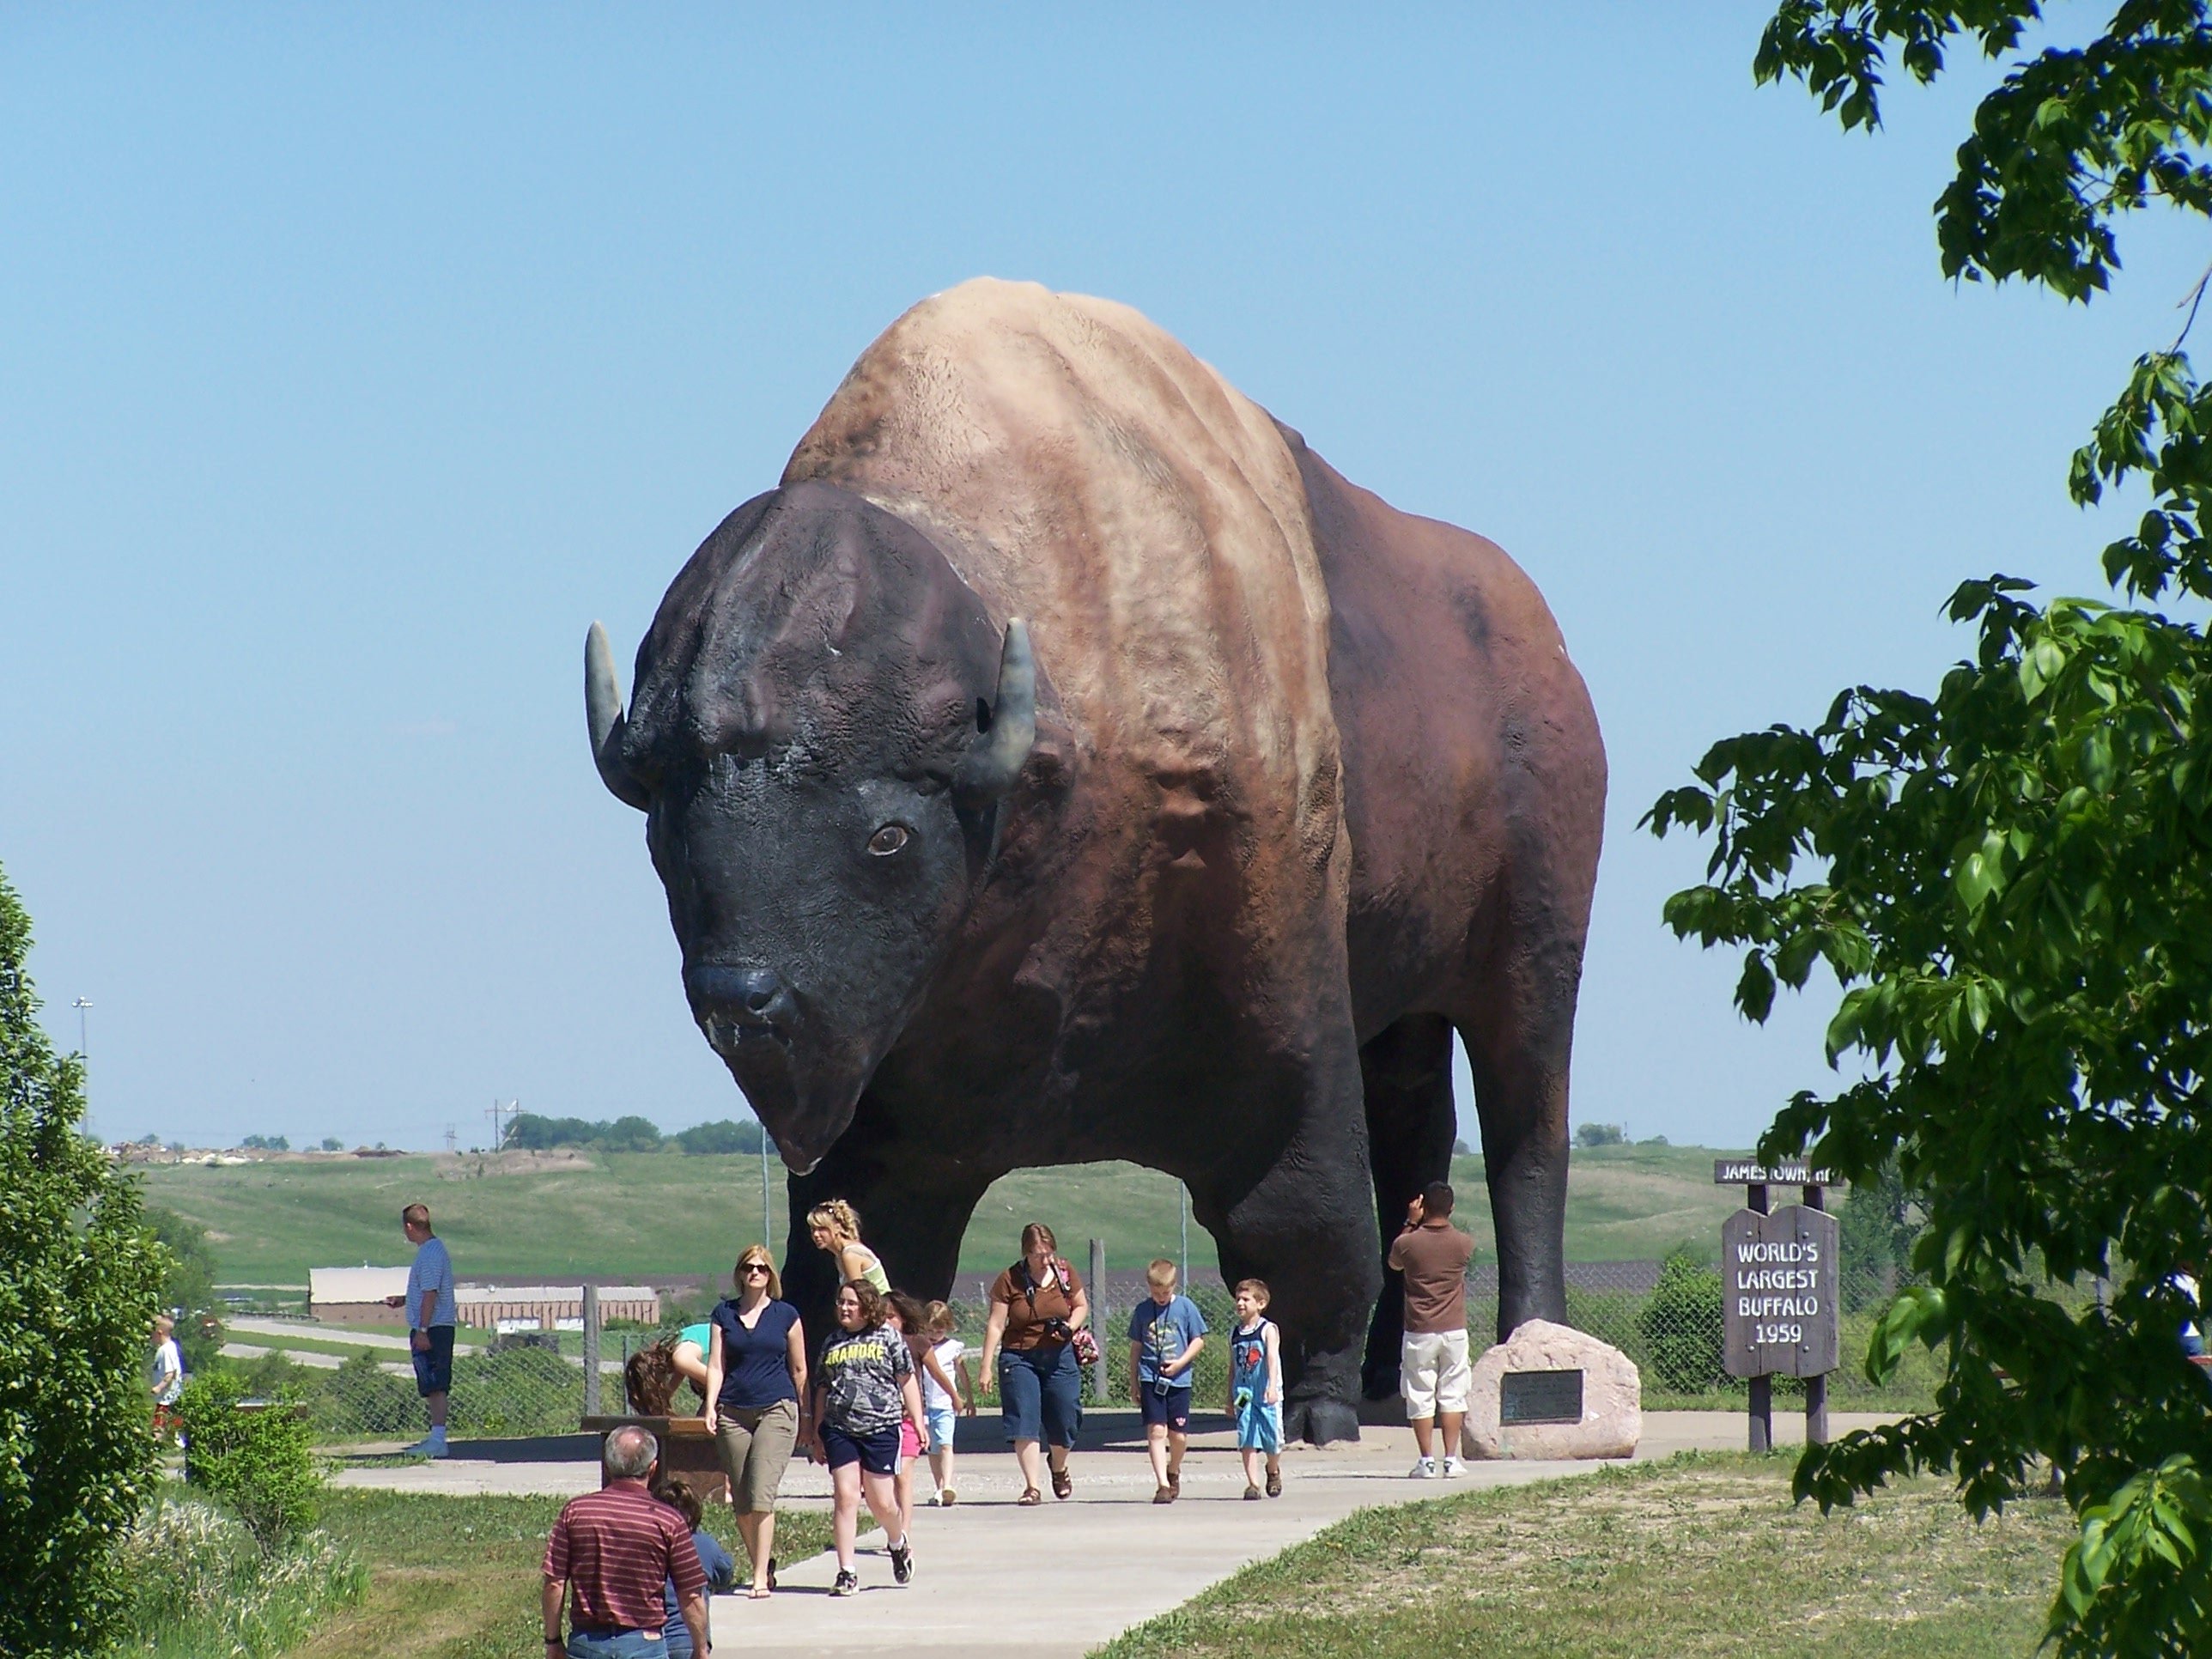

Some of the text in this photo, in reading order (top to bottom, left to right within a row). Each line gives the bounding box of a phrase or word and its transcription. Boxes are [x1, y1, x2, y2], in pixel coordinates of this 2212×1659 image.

[1738, 1243, 1819, 1262] WORLD'S
[1737, 1269, 1819, 1290] LARGEST
[1739, 1296, 1818, 1316] BUFFALO
[1756, 1323, 1802, 1343] 1959
